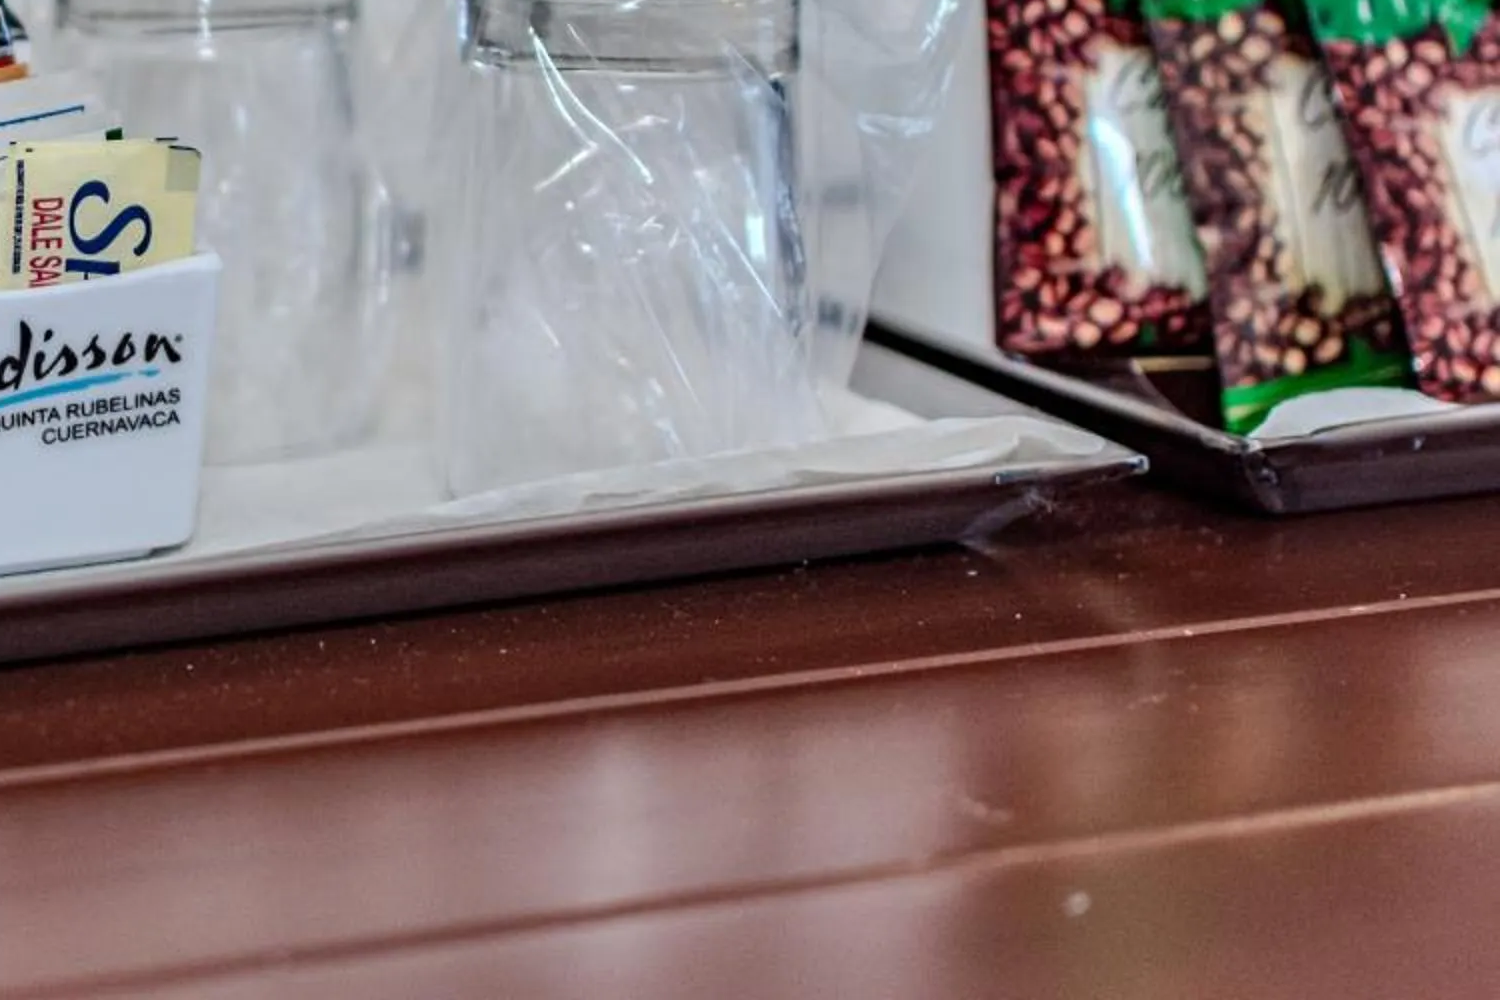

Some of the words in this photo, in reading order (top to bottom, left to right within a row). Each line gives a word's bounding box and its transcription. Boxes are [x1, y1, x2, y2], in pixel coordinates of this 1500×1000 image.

[31, 197, 64, 251] DALE
[65, 387, 181, 419] RUBELINAS
[41, 410, 181, 445] CUERNAVACA
